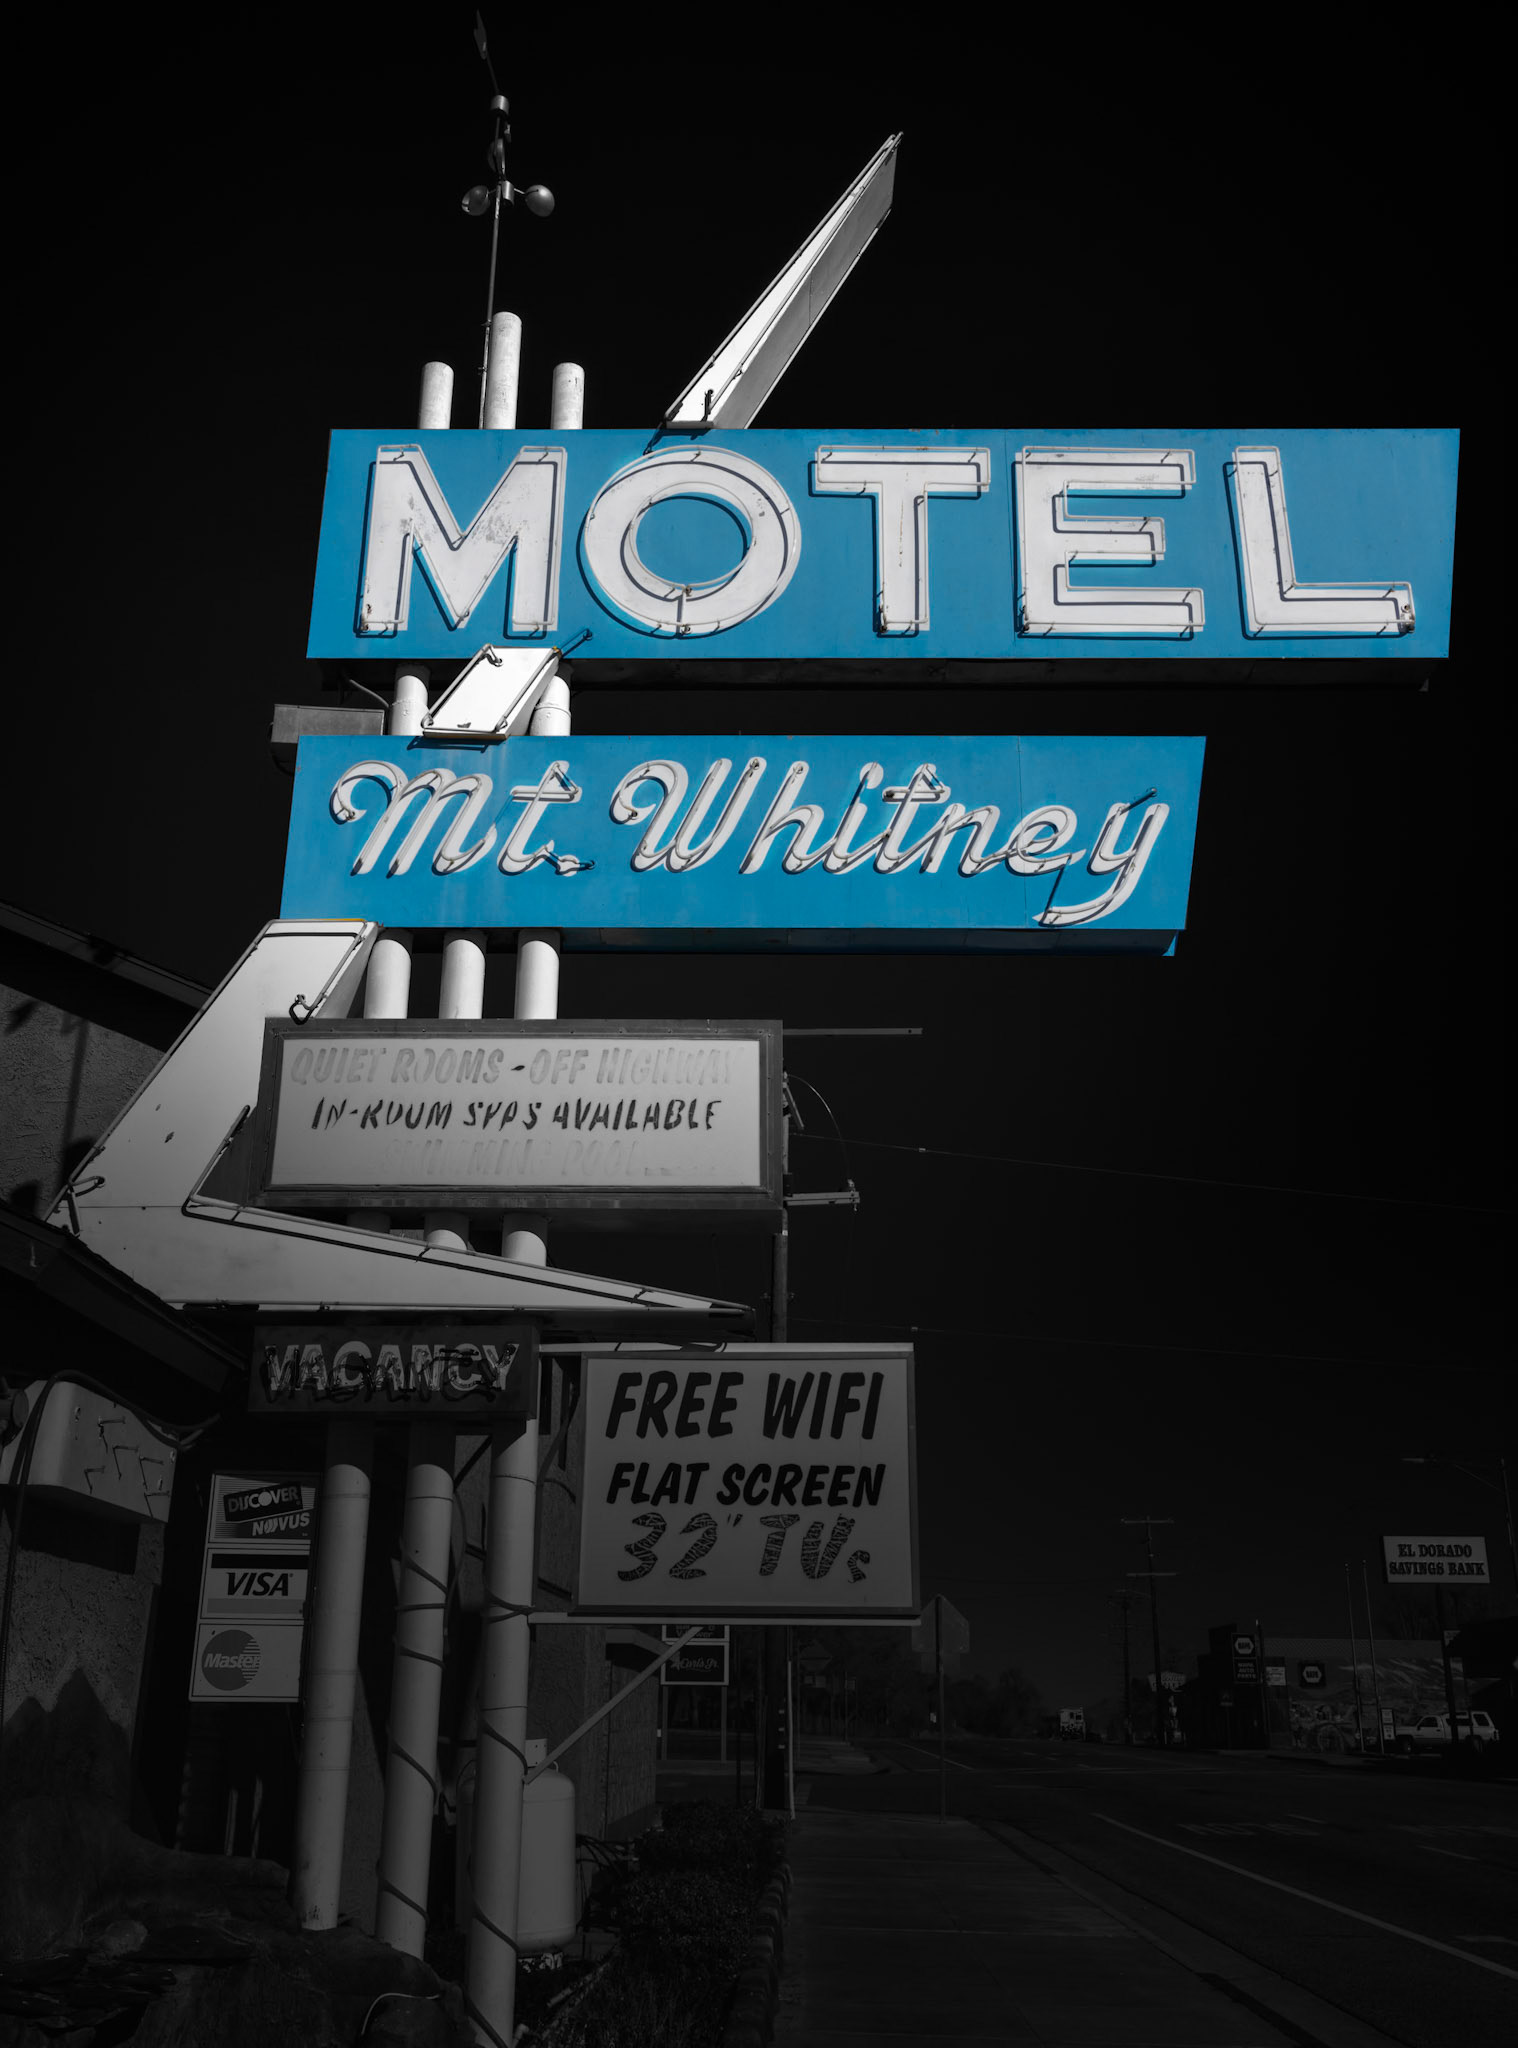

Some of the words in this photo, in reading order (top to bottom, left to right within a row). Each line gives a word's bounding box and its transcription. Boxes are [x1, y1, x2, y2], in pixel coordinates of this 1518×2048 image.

[356, 443, 1415, 638] MOTEL
[329, 759, 590, 877] Mt.
[609, 755, 1172, 927] Whitney
[290, 1047, 387, 1086] QUIET
[390, 1047, 505, 1085] ROOMS
[529, 1047, 589, 1086] OFF
[552, 1097, 723, 1132] AVAILABLE
[261, 1340, 520, 1396] VACANCY
[605, 1370, 744, 1440] FREE
[762, 1371, 884, 1440] WIFI
[227, 1485, 299, 1513] DISCOVER
[606, 1462, 710, 1507] FLAT
[716, 1463, 886, 1508] SCREEN
[252, 1511, 311, 1537] NOVUS
[1389, 1561, 1445, 1576] SAVINGS
[1447, 1561, 1486, 1576] BANK
[1397, 1543, 1416, 1558] EL
[1418, 1543, 1473, 1558] DORADO
[226, 1571, 290, 1597] VISA
